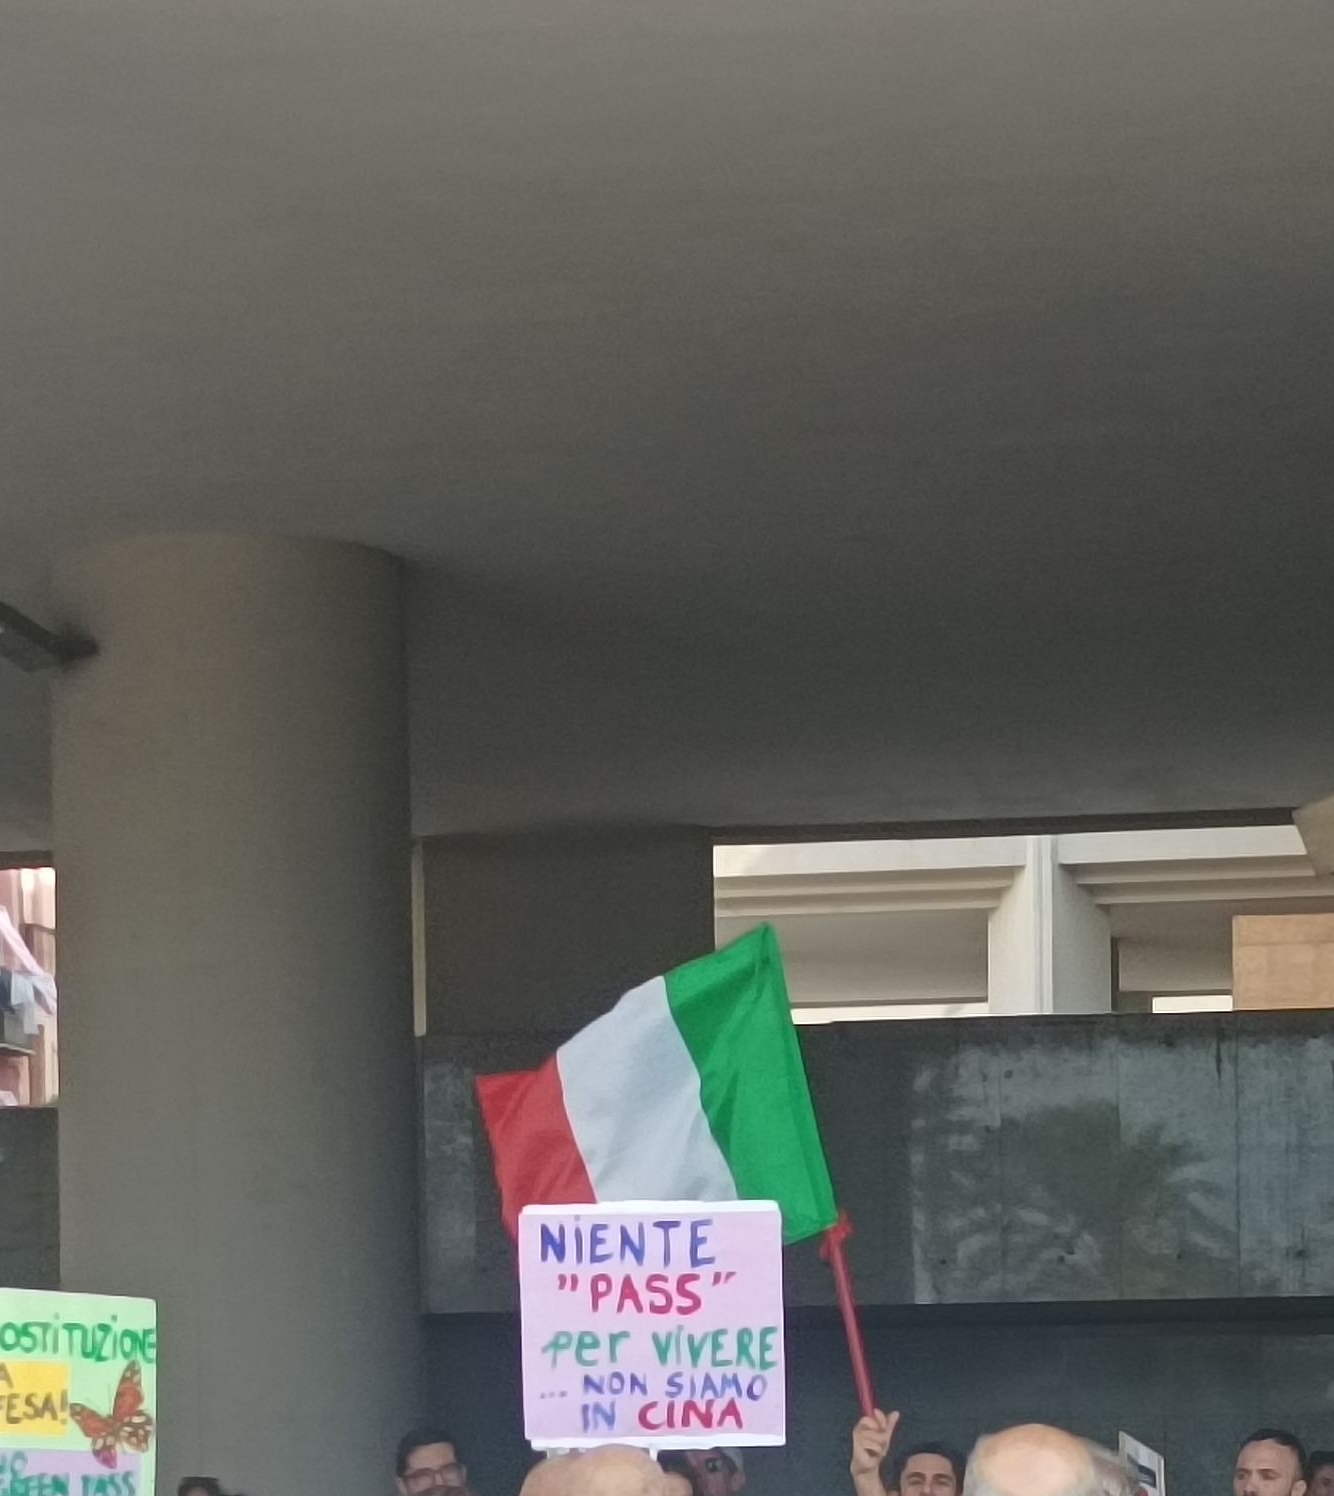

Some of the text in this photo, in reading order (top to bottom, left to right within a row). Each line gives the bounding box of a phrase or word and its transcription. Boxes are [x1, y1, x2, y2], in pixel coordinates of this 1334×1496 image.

[651, 1324, 779, 1371] VIVERE
[583, 1371, 648, 1396] NON
[665, 1371, 767, 1401] SIAMO
[581, 1397, 744, 1433] IN CINA
